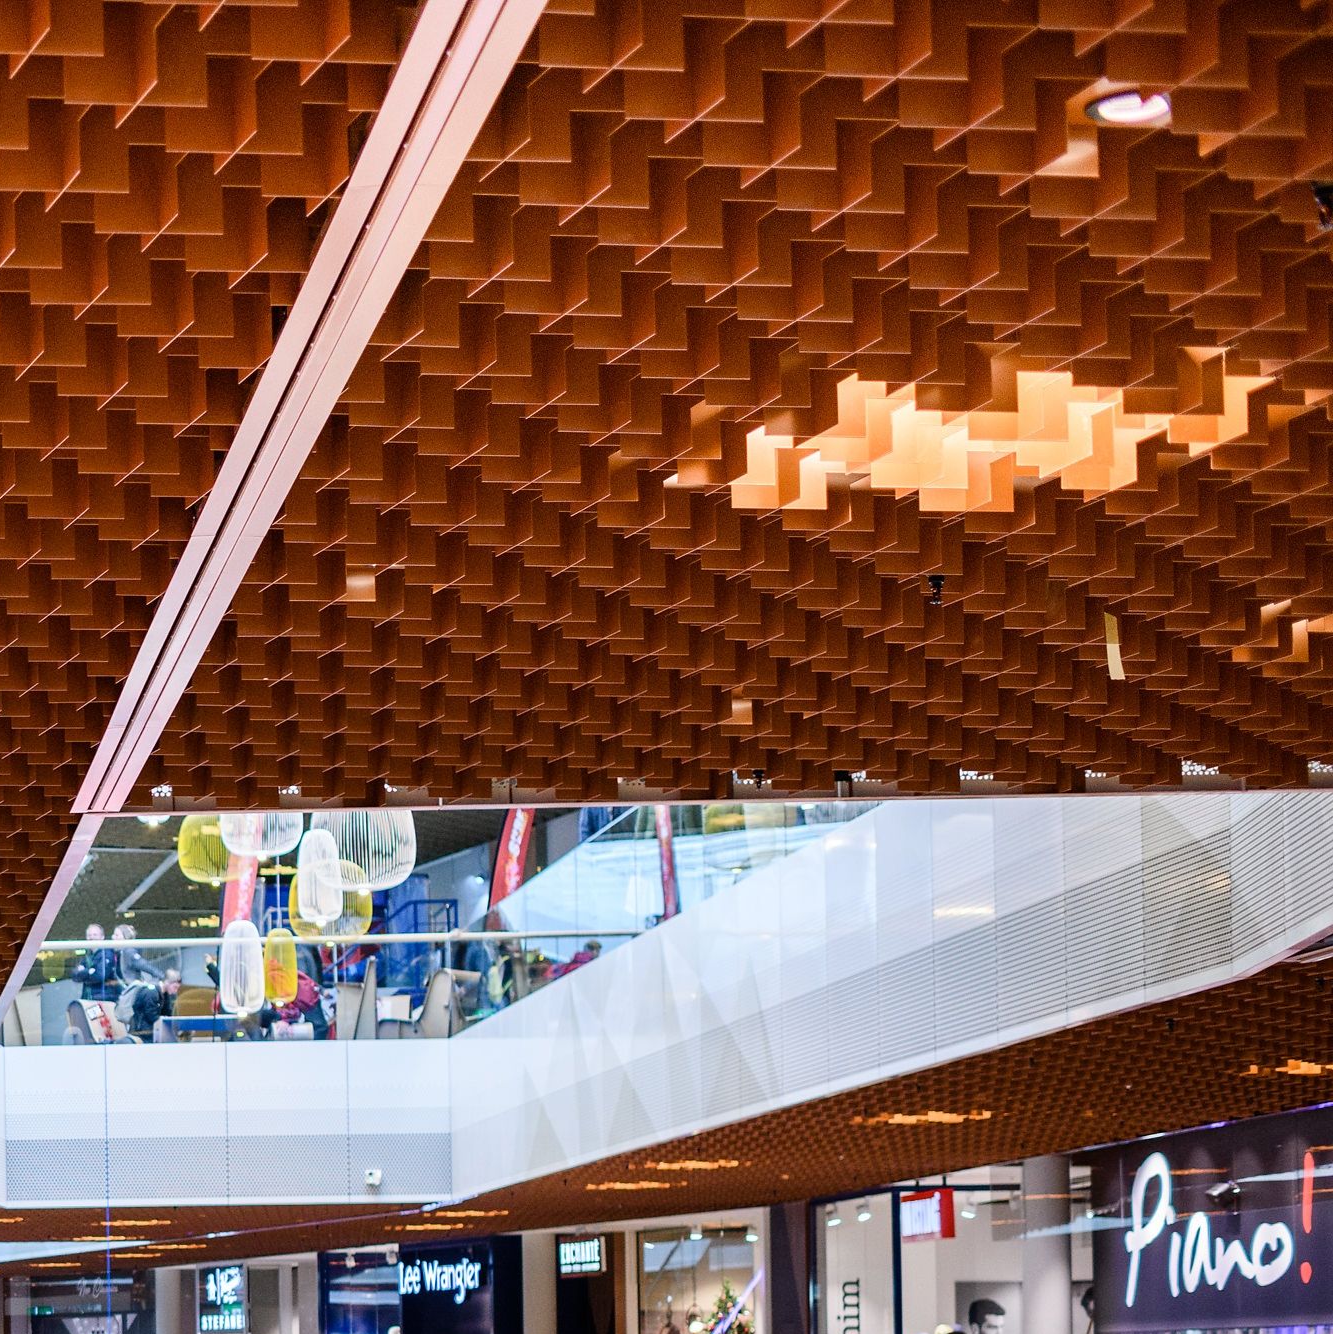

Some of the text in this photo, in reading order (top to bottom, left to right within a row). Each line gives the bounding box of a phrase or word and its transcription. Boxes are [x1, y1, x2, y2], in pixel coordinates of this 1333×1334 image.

[1124, 1151, 1315, 1308] Piano!
[398, 1257, 481, 1305] Lee Wrangler
